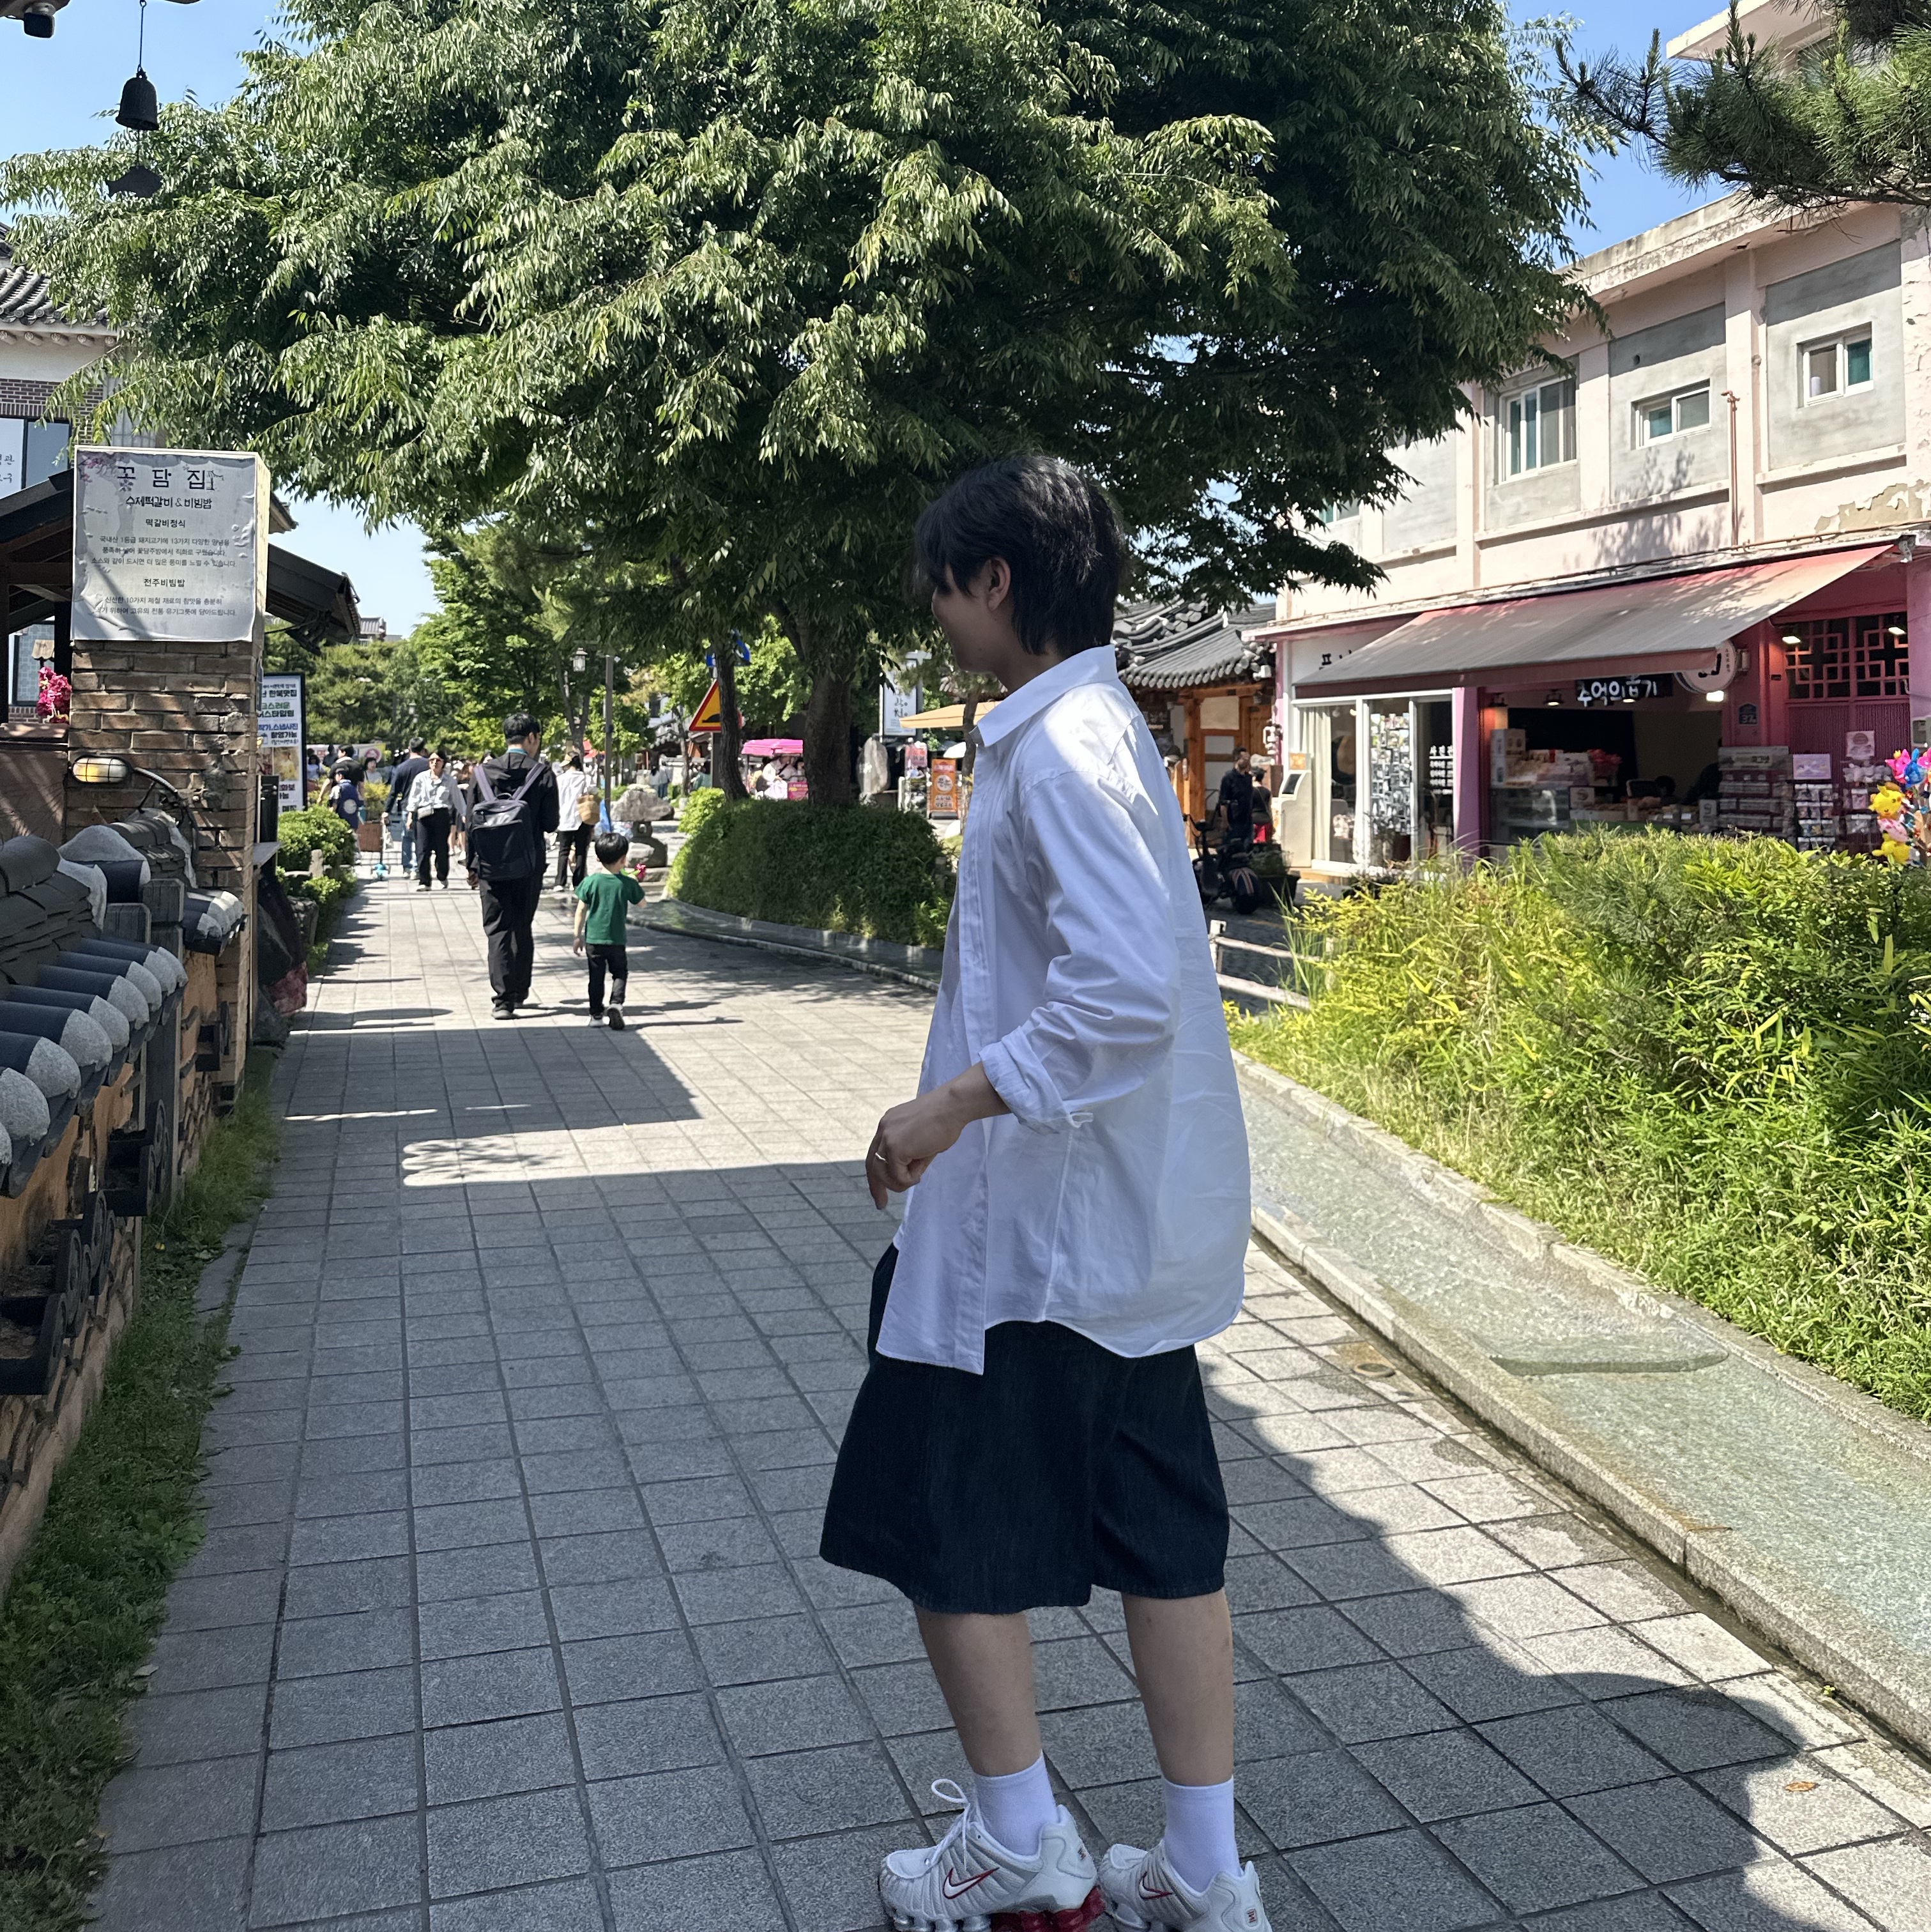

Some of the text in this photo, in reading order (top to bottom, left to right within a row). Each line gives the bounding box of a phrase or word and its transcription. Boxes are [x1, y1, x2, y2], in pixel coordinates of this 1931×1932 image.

[125, 496, 212, 509] 수제떡갈비 & 비빔밥
[145, 519, 186, 528] 떡갈비정식
[144, 578, 185, 587] 전주비빔밥
